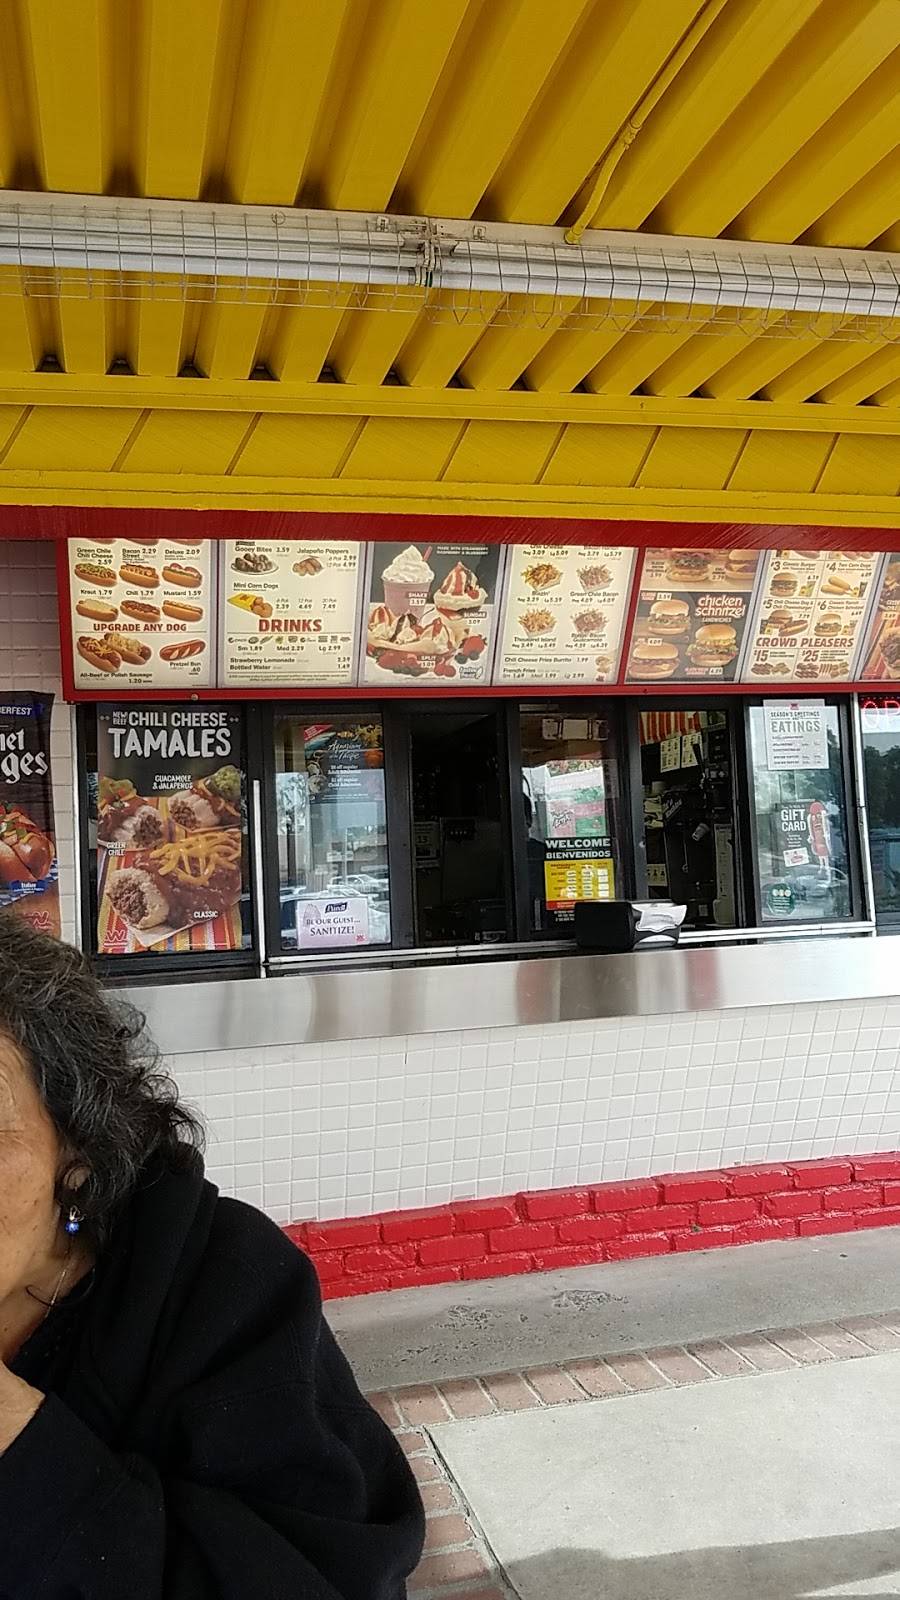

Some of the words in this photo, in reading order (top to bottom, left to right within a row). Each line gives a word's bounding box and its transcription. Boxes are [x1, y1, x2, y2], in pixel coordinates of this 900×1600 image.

[698, 594, 743, 606] chicken
[695, 604, 747, 619] schnitzel
[93, 623, 140, 632] UPGRADE
[143, 623, 163, 632] ANY
[166, 623, 187, 632] DOG
[259, 619, 322, 632] DRINKS
[756, 638, 797, 647] CROWD
[801, 638, 854, 647] PLEASERS
[754, 650, 769, 661] $15
[802, 650, 819, 661] $25
[128, 712, 167, 726] CHILI
[171, 712, 227, 727] CHEESE
[771, 720, 820, 733] EATINGS
[108, 728, 231, 758] TAMALES
[781, 809, 805, 821] GIFT
[782, 821, 807, 831] CARD
[545, 838, 611, 849] WELCOME
[546, 850, 611, 859] BIENVENIDOS
[310, 926, 354, 936] SANITIZE!
